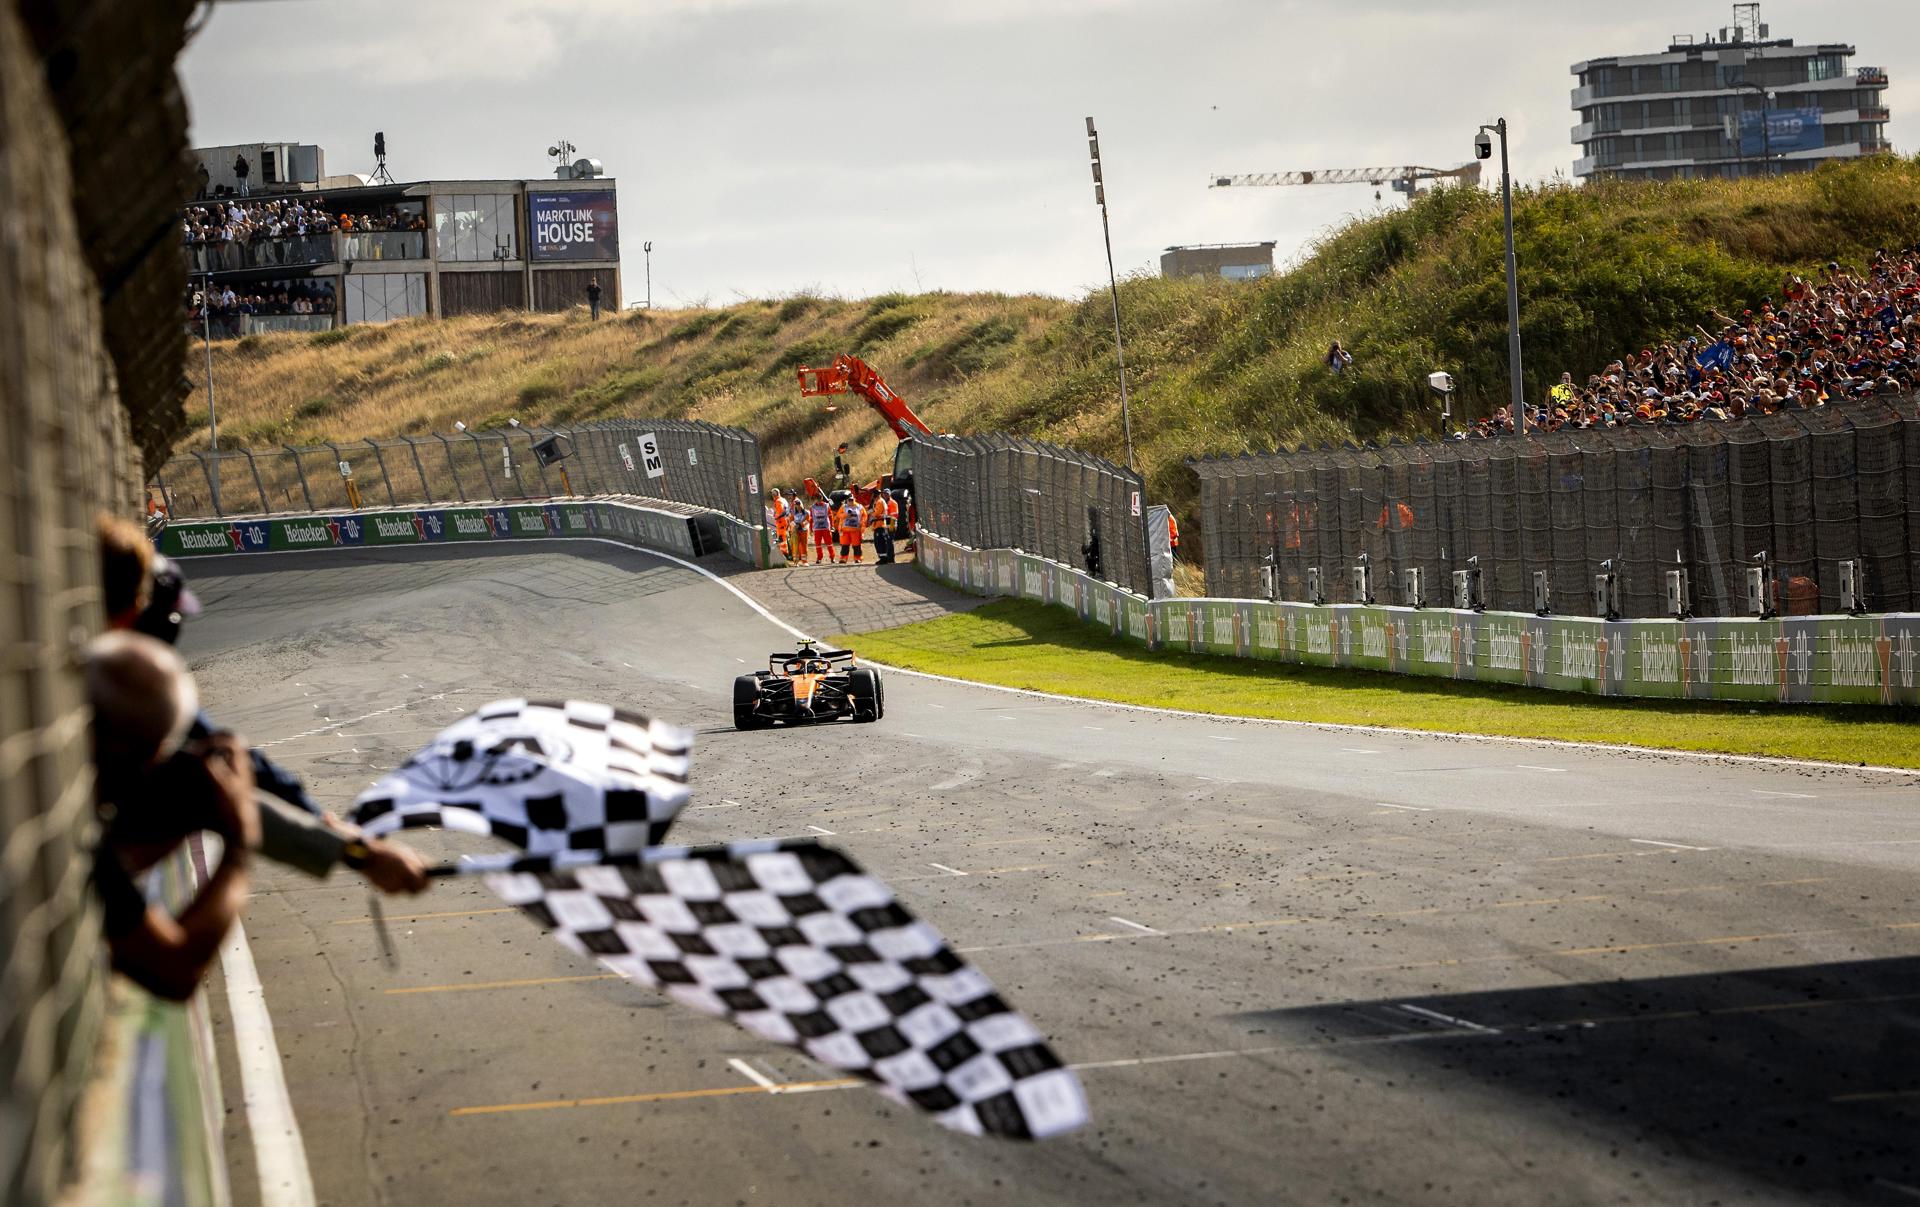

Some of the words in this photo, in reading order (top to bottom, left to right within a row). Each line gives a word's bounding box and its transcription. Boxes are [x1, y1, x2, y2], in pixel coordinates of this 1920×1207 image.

[537, 209, 593, 222] MARKTLINK
[537, 222, 594, 243] HOUSE
[284, 522, 328, 543] Heineken
[375, 516, 414, 537] Heineken
[453, 513, 488, 534] Heineken
[178, 529, 228, 549] Heineken
[1730, 631, 1774, 686] Heineken
[1830, 628, 1875, 687] Heineken
